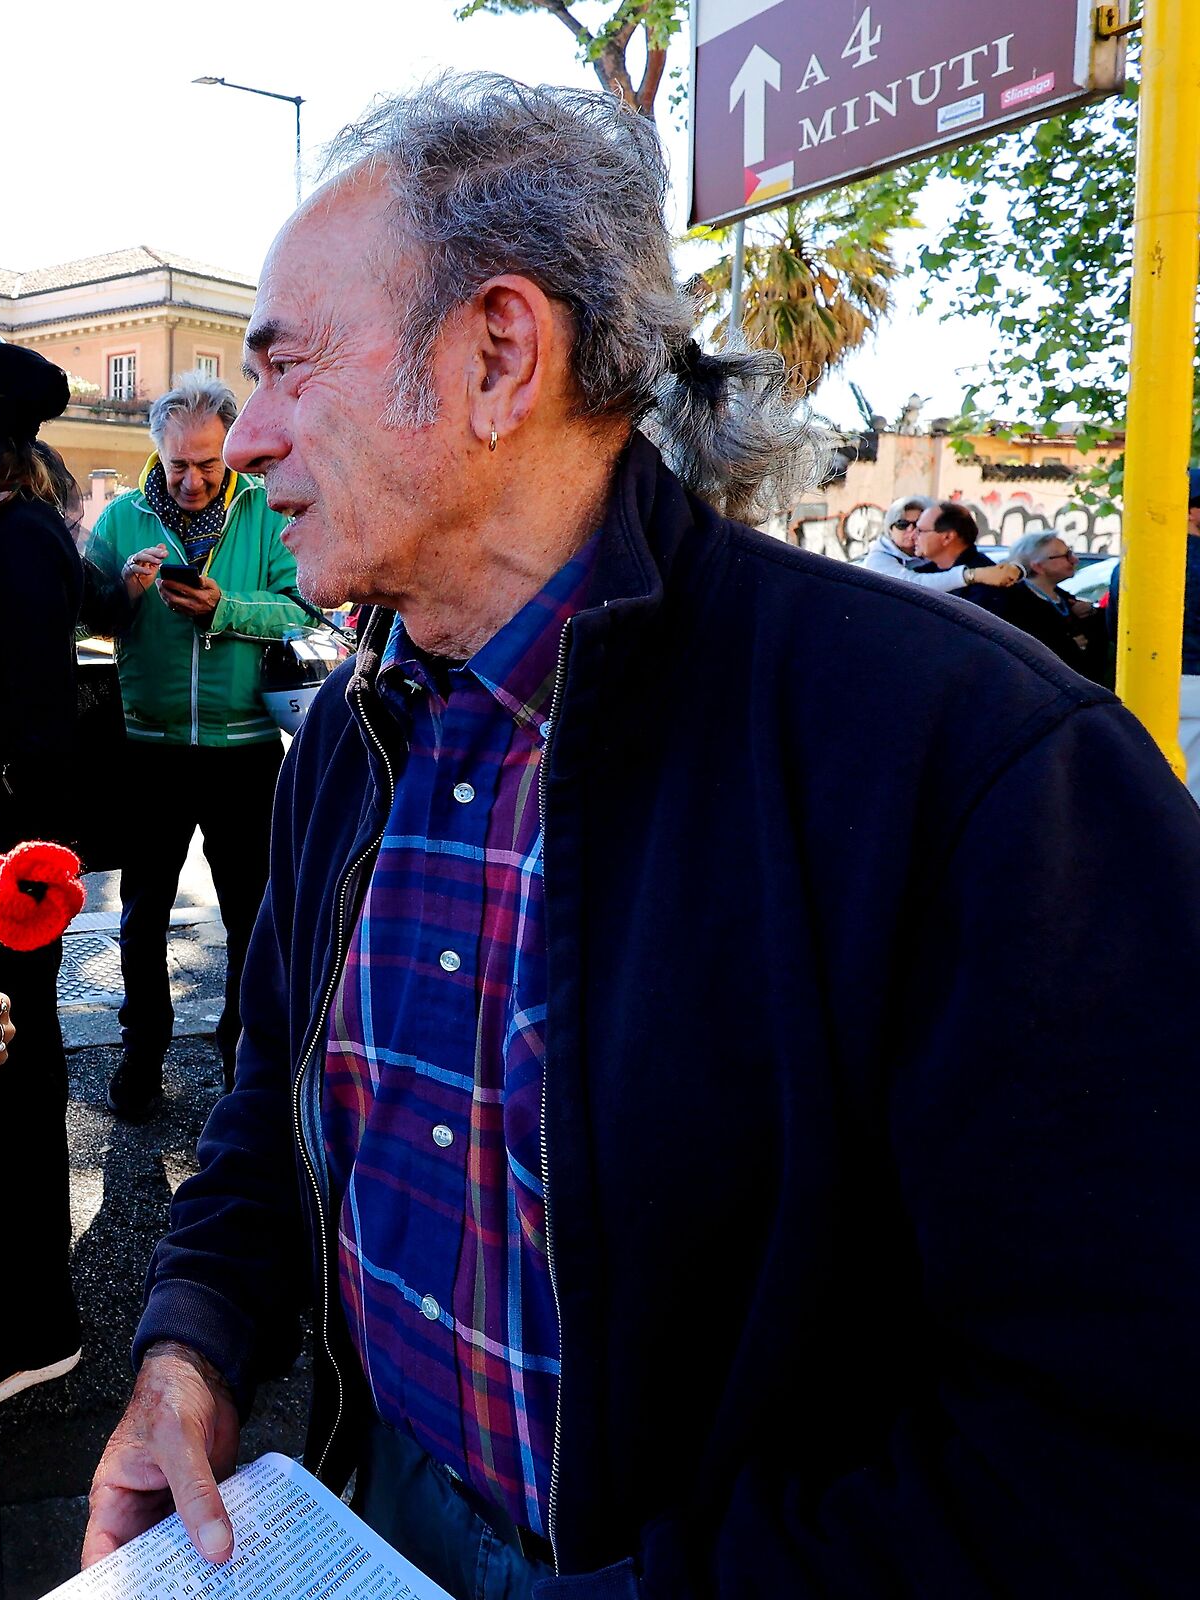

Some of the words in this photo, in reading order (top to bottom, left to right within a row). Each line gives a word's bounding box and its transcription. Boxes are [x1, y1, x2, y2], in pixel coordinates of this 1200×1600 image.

[797, 54, 829, 94] A
[841, 6, 883, 70] 4
[798, 33, 1016, 152] MINUTI
[1003, 78, 1051, 104] Slinzega
[266, 1471, 286, 1488] anche
[256, 1484, 302, 1521] L'APPLICAZIONE
[262, 1491, 310, 1530] RISANAMENTO
[295, 1498, 318, 1518] PIENA
[234, 1520, 256, 1538] DELLE
[270, 1515, 297, 1539] TUTELA
[316, 1525, 333, 1540] fatto
[330, 1519, 339, 1528] di
[337, 1527, 346, 1537] su
[236, 1530, 260, 1551] DEGLI
[248, 1536, 272, 1557] DELLA
[328, 1534, 339, 1546] cui
[150, 1547, 185, 1574] LAVORO,
[220, 1554, 249, 1579] SALUTE
[274, 1541, 315, 1577] normalmente
[295, 1547, 324, 1575] calcolano
[334, 1542, 363, 1571] TRIENNIO
[352, 1550, 371, 1570] PUNTI
[180, 1557, 208, 1581] ELATIVE
[145, 1574, 166, 1592] legge
[181, 1584, 193, 1595] DI
[213, 1576, 222, 1585] E
[237, 1577, 254, 1592] come
[270, 1574, 294, 1597] rinnovi
[316, 1566, 355, 1600] QUALIFICAN
